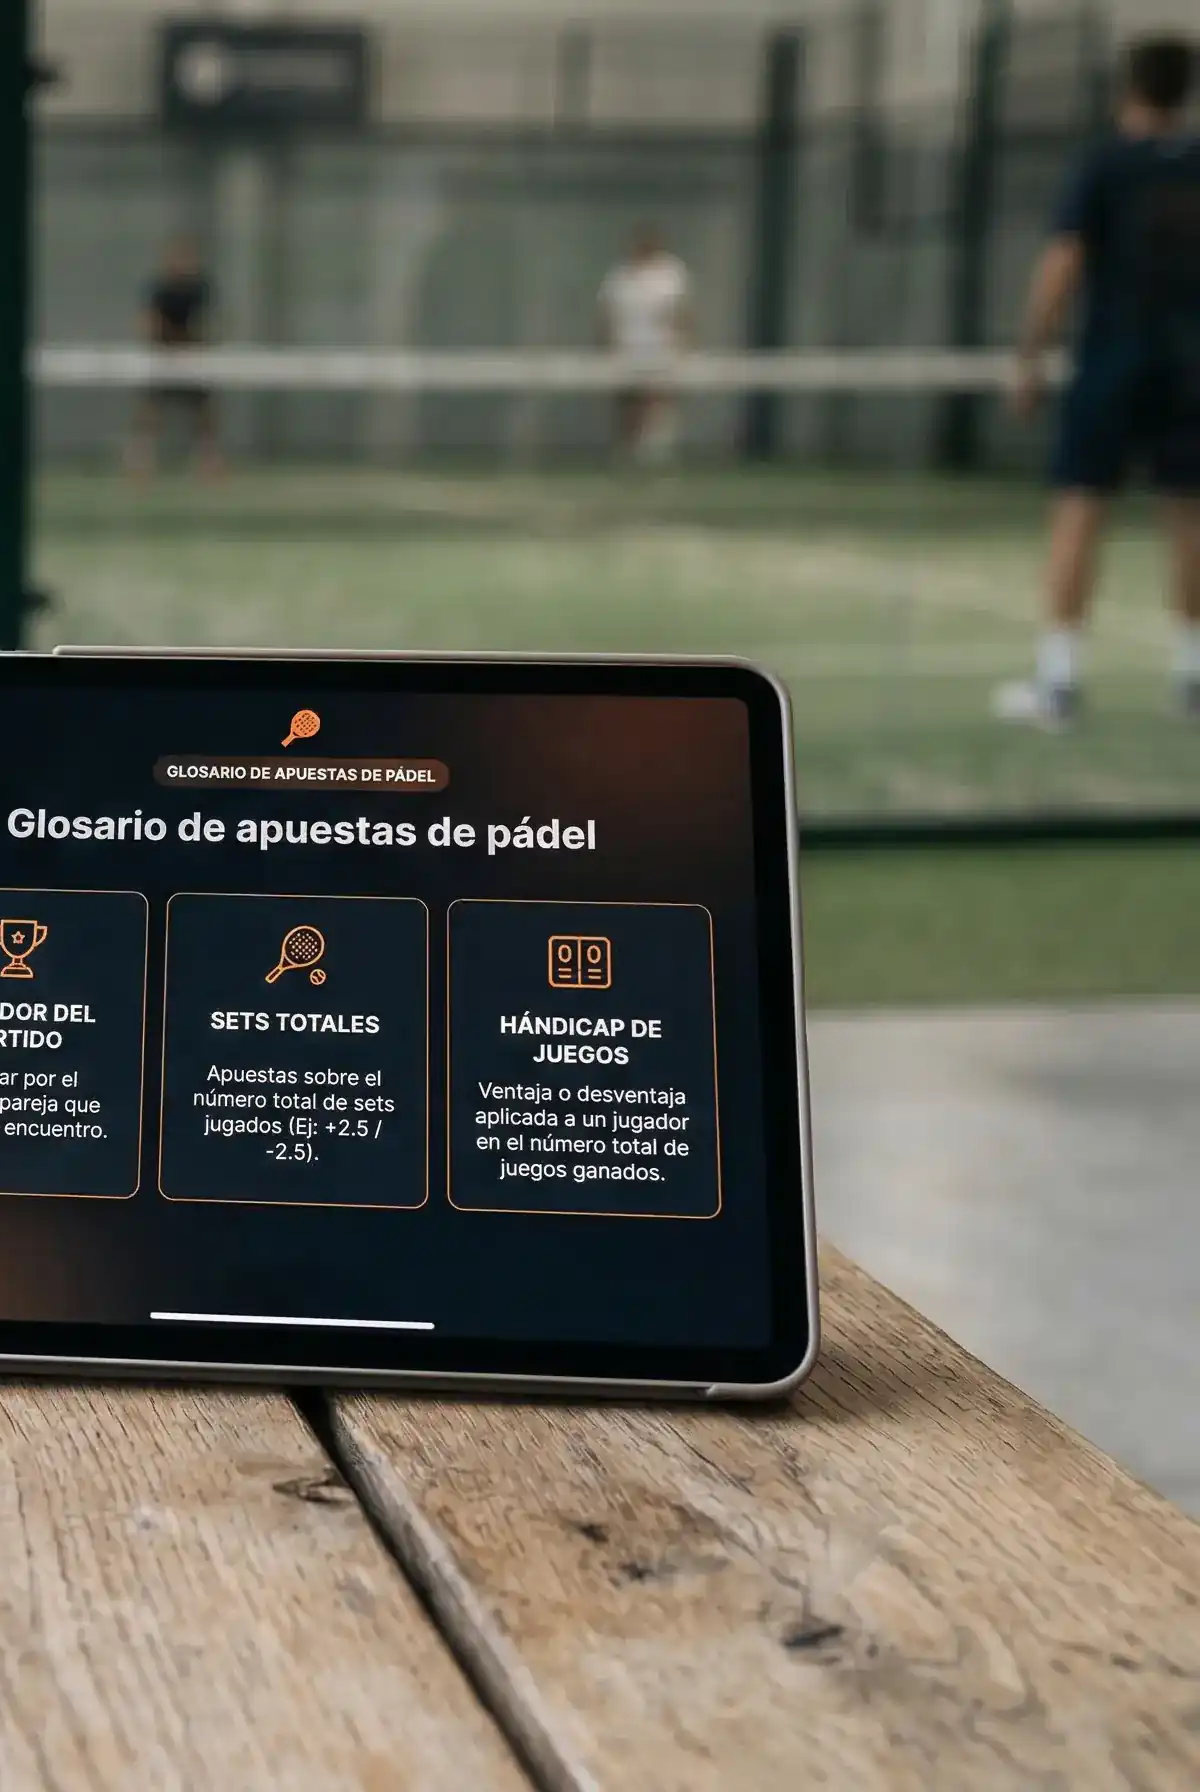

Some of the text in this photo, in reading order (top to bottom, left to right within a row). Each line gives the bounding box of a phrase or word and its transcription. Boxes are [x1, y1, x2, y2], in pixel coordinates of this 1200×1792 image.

[166, 765, 436, 783] GLOSARIO DE APUESTAS DE PÁDEL
[7, 807, 596, 856] Glosario de apuestas de pádel
[53, 1003, 96, 1024] DEL
[210, 1011, 380, 1034] SETS TOTALES
[500, 1011, 663, 1039] HÁNDICAP DE
[532, 1043, 630, 1065] JUEGOS
[23, 1073, 57, 1091] por
[61, 1070, 78, 1088] el
[206, 1065, 381, 1088] Apuestas sobre el
[193, 1088, 395, 1113] número total de sets
[477, 1081, 686, 1109] Ventaja o desventaja
[63, 1099, 101, 1117] que
[3, 1120, 108, 1139] encuentro.
[203, 1115, 384, 1140] jugados (Ej: +2.5 /
[475, 1107, 690, 1134] aplicada a un jugador
[265, 1142, 319, 1164] -2.5).
[476, 1133, 690, 1157] en el número total de
[499, 1158, 666, 1183] juegos ganados.
